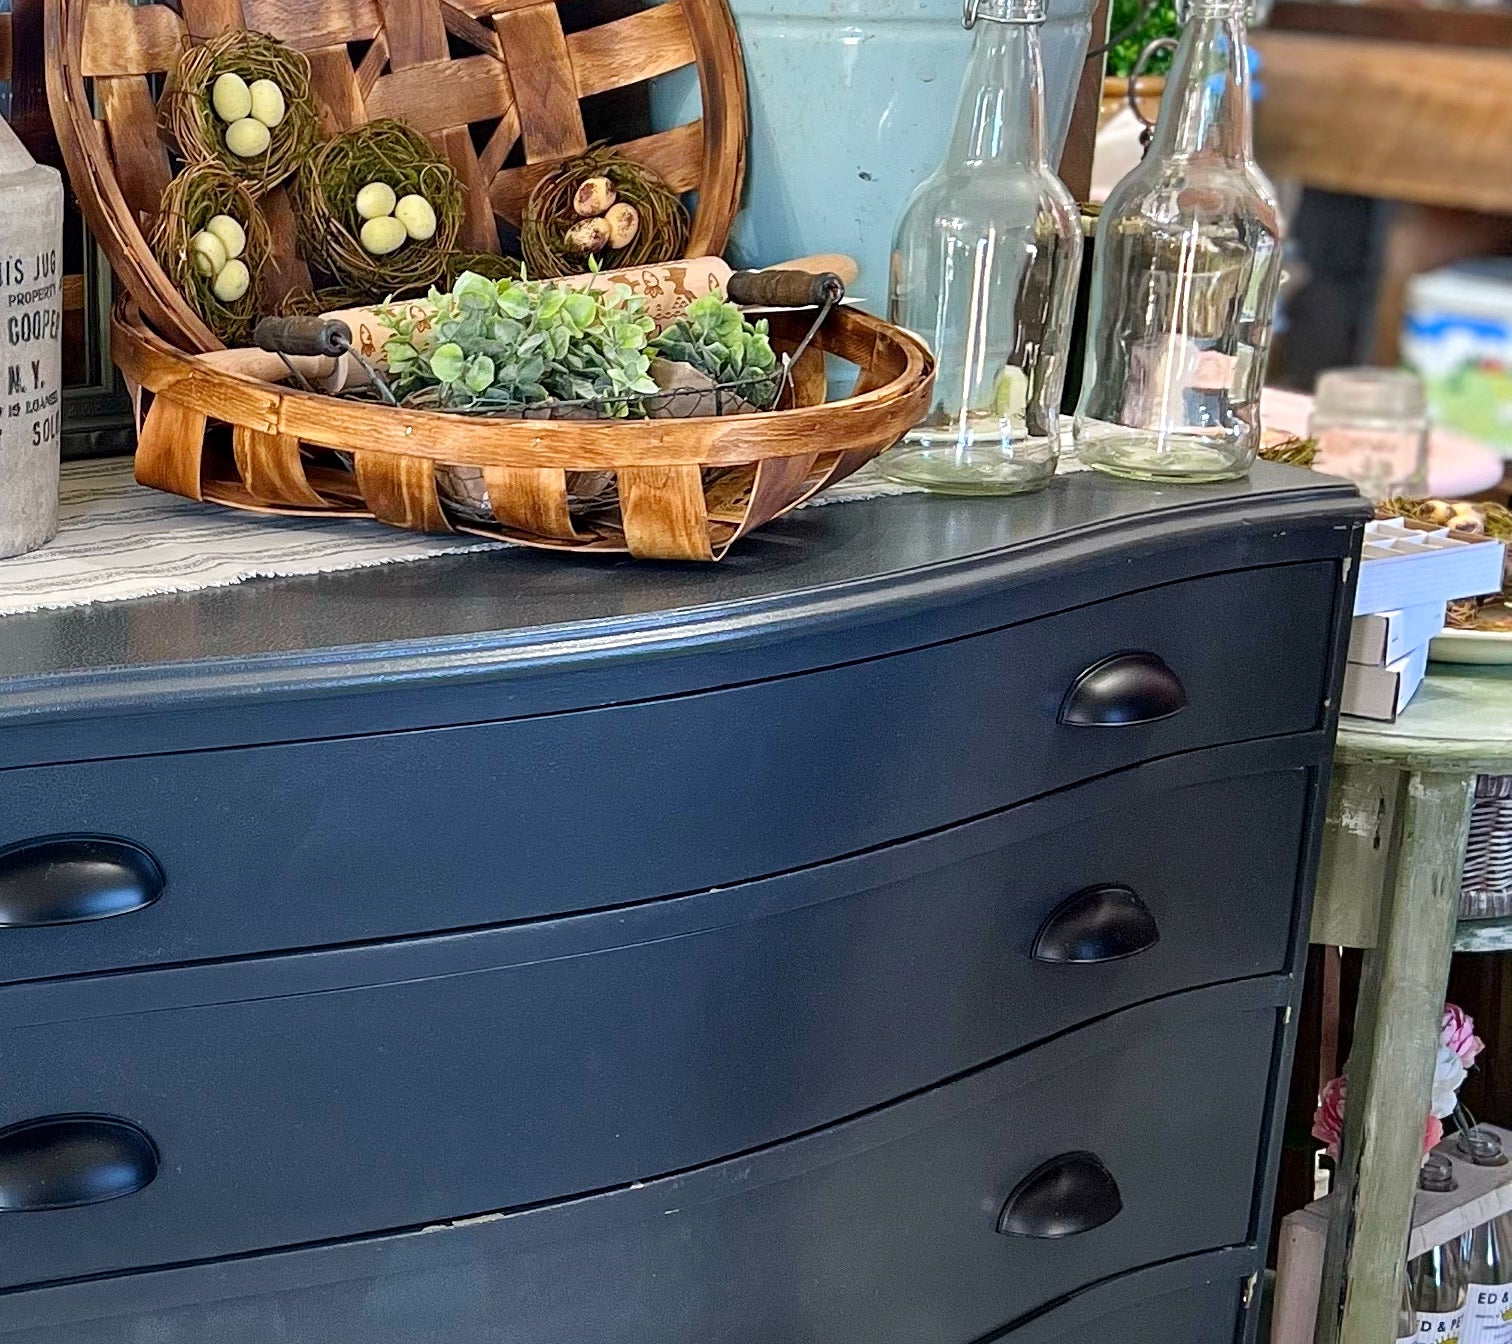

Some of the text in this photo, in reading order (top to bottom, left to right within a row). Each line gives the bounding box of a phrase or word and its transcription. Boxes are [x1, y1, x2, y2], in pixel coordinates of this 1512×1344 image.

[34, 250, 56, 281] JUG
[1478, 1292, 1498, 1305] ED
[1437, 1321, 1446, 1332] &
